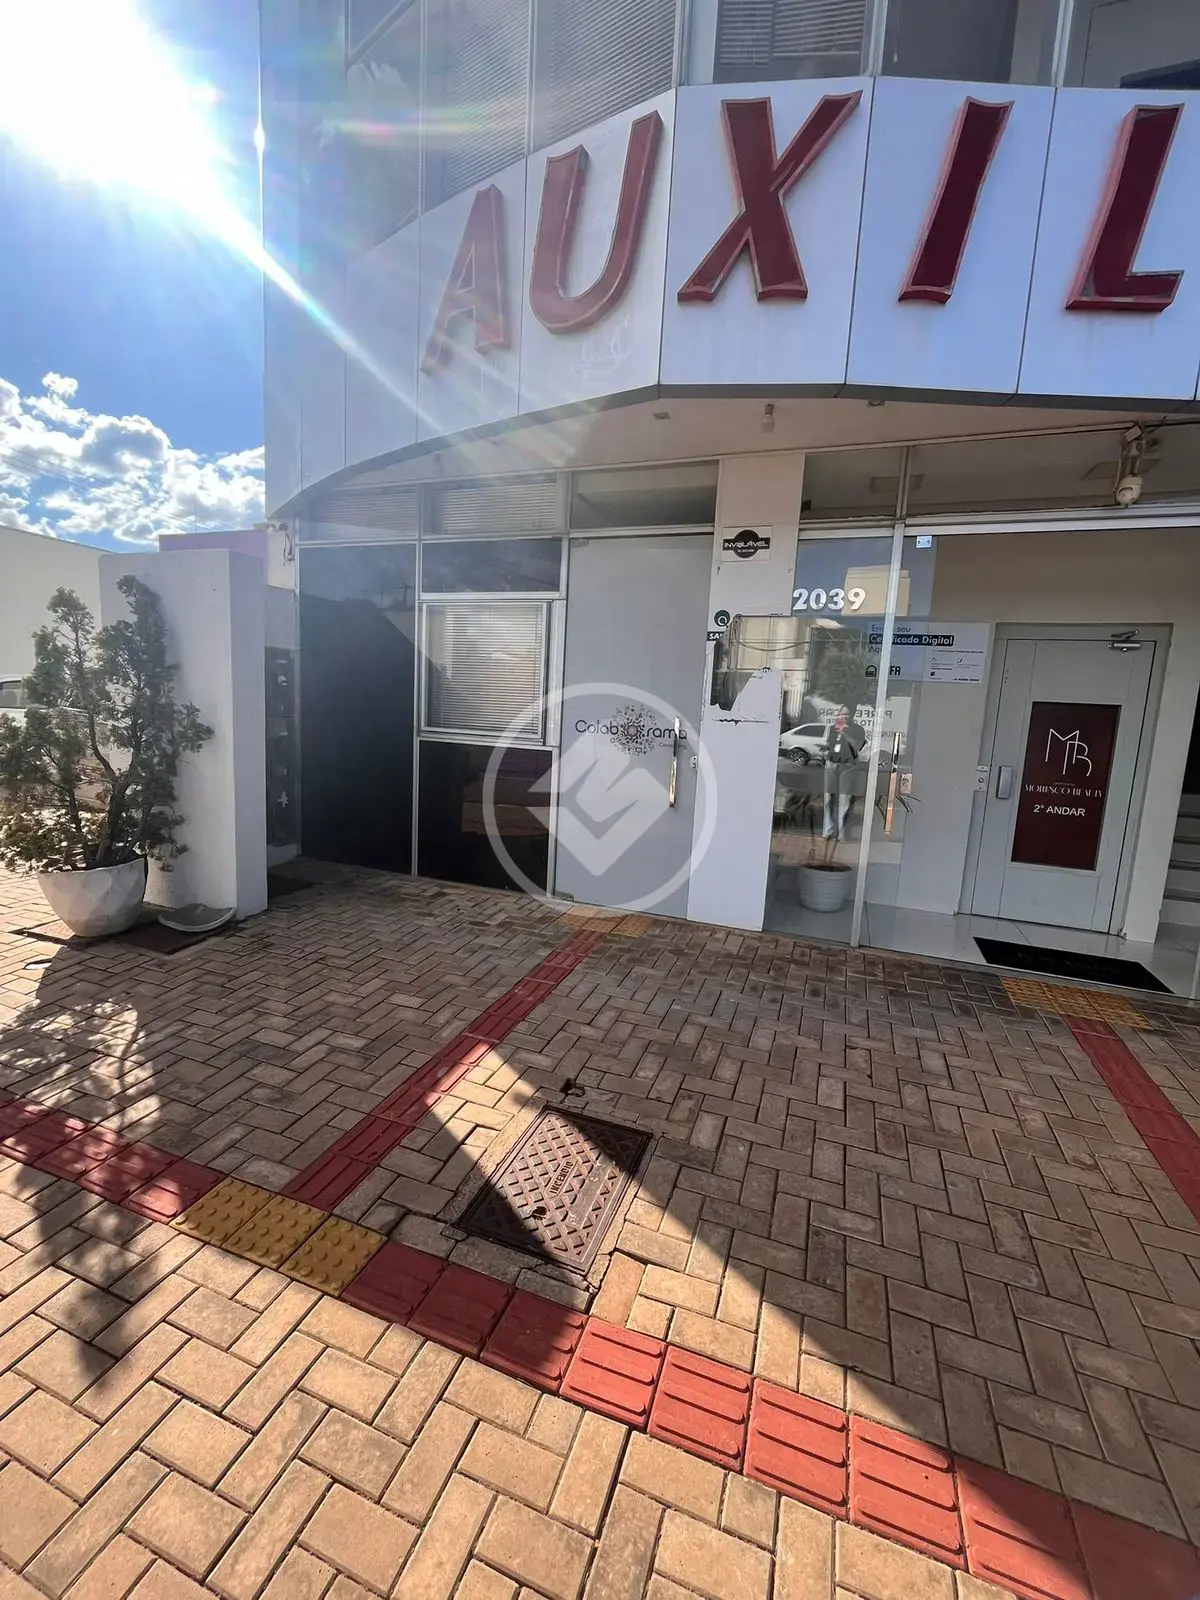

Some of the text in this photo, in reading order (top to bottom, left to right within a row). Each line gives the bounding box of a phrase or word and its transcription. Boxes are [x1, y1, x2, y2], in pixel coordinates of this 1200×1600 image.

[793, 587, 866, 612] 2039
[922, 635, 953, 645] Digital
[1046, 805, 1086, 817] ANDAR
[549, 1160, 574, 1195] INCENDIO
